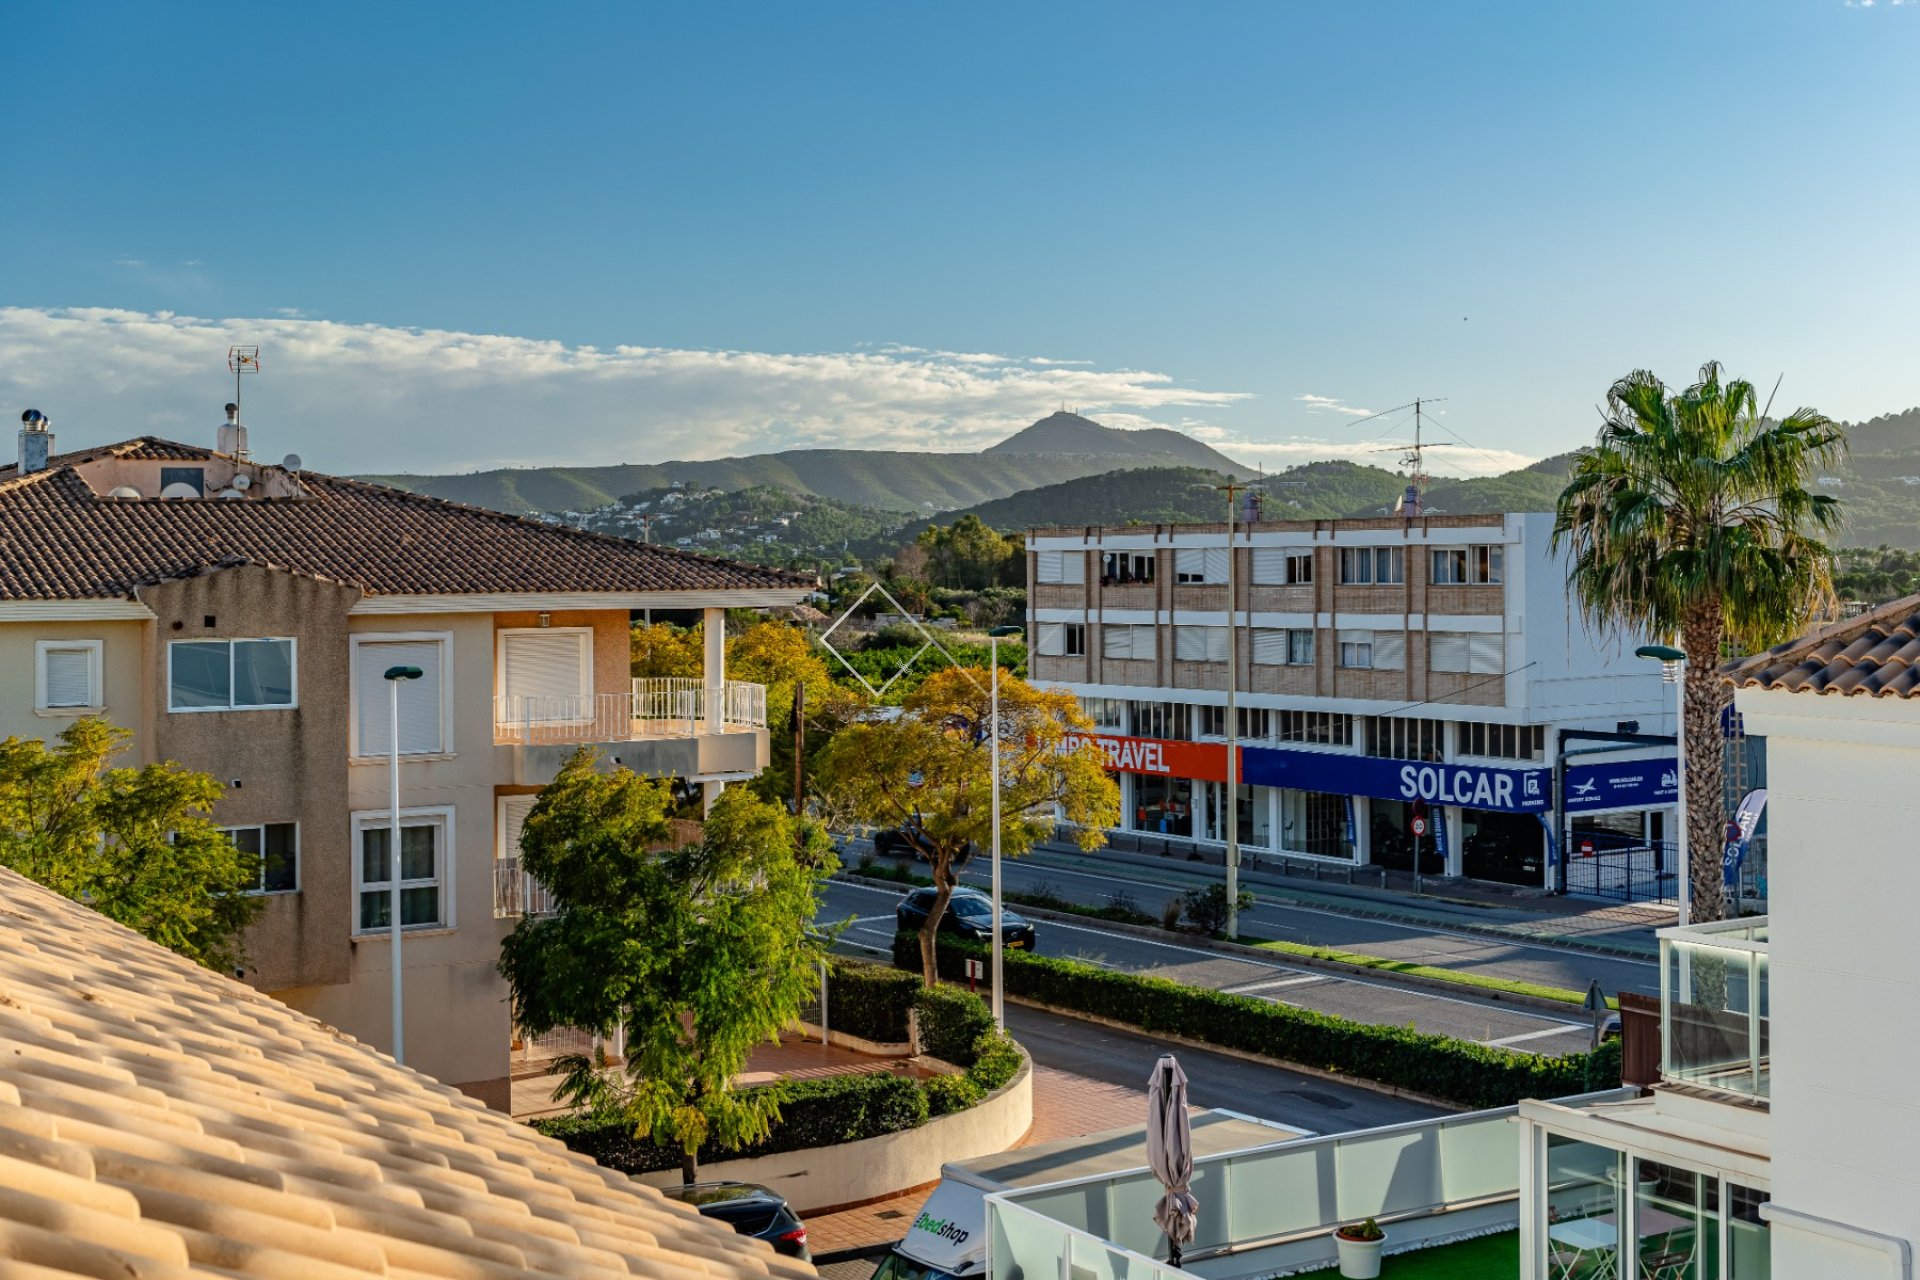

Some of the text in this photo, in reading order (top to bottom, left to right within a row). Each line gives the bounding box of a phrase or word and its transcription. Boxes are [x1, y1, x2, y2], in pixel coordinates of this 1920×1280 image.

[1095, 738, 1170, 773] TRAVEL
[1400, 765, 1514, 808] SOLCAR
[1522, 799, 1544, 807] PARKING
[918, 1213, 969, 1246] bedshop
